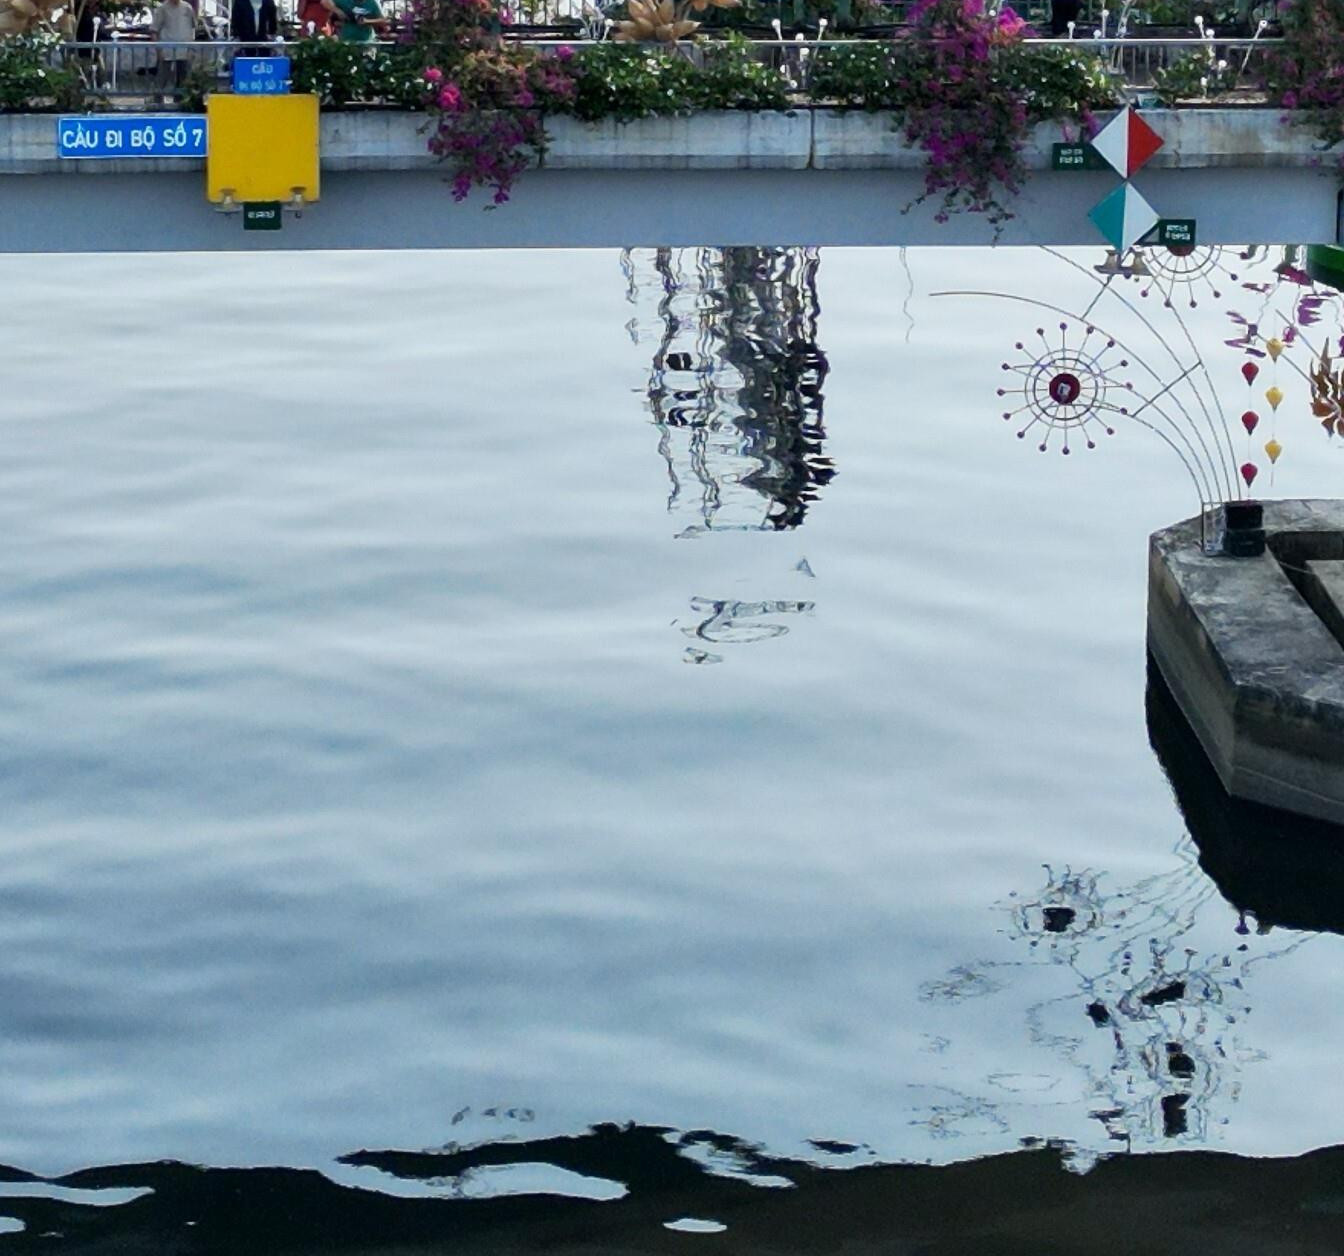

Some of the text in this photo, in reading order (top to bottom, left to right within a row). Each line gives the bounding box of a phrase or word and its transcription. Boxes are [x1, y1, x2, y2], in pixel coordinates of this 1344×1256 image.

[62, 120, 203, 152] CẦU ĐI BỘ SỐ 7
